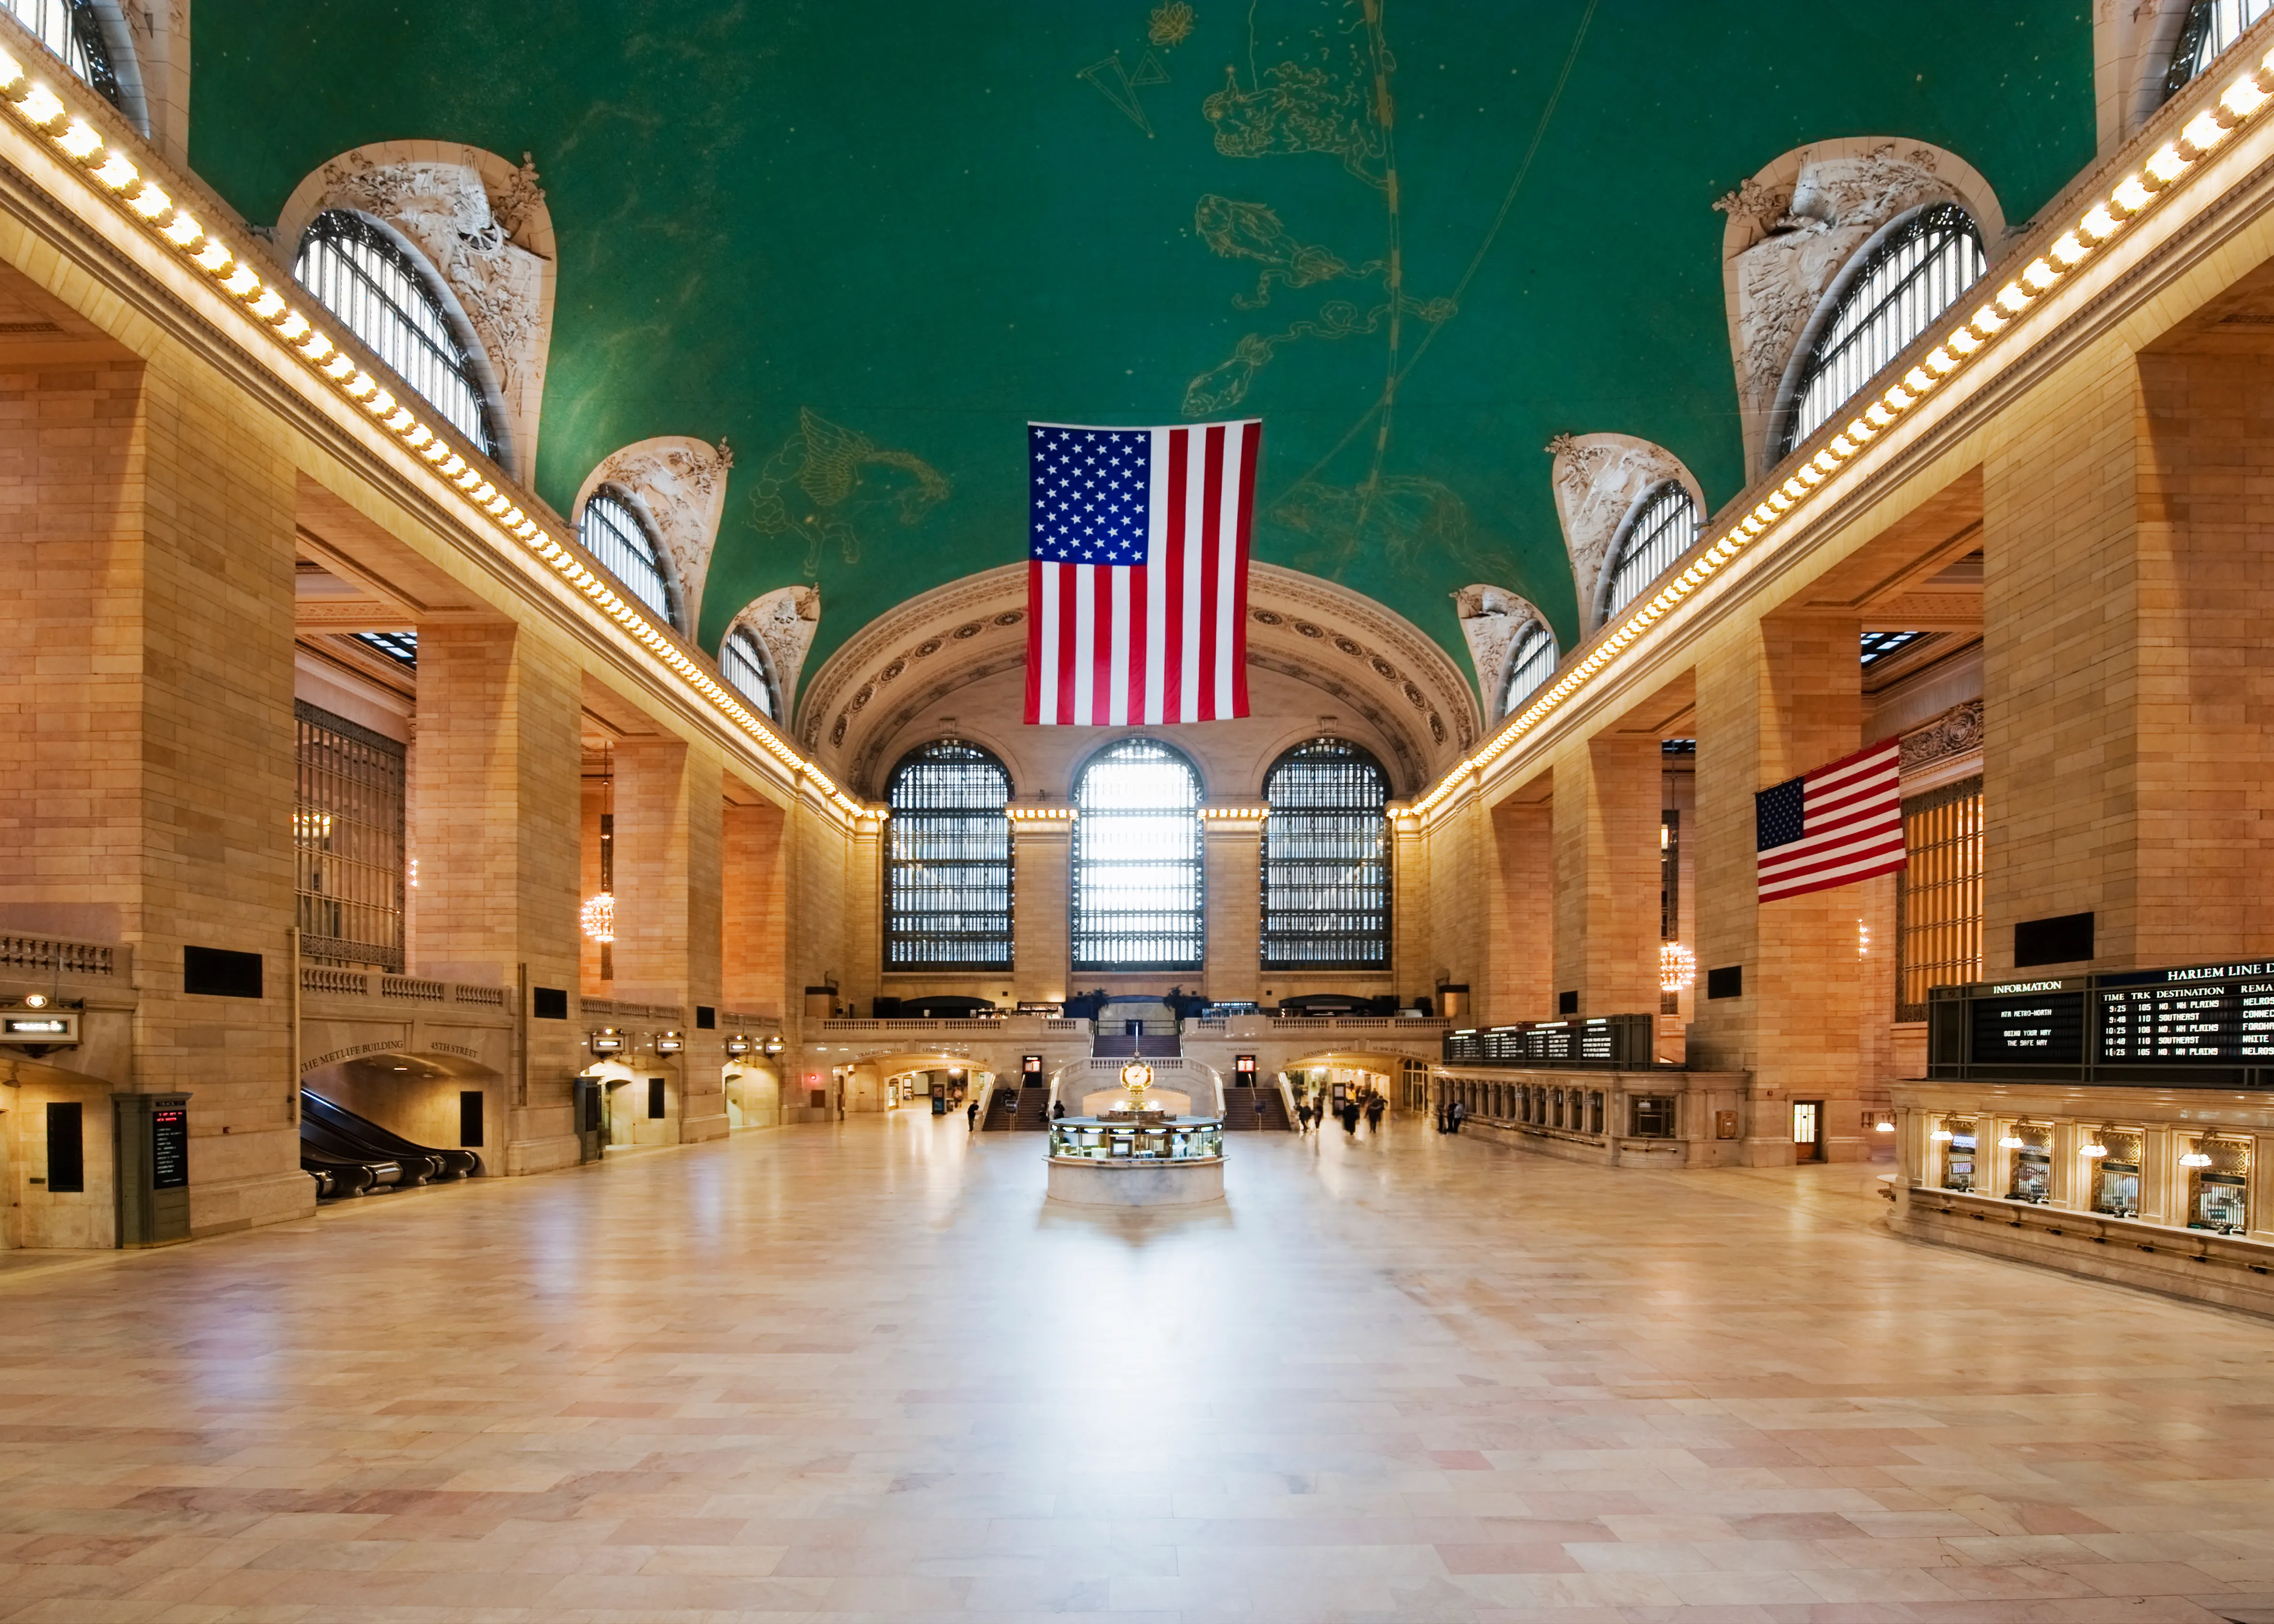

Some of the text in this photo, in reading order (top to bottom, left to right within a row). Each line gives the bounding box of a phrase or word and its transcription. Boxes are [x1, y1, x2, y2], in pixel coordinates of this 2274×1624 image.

[2168, 967, 2224, 981] HARLEM
[2228, 964, 2262, 976] LINE
[1993, 981, 2062, 994] INFORMATION
[2131, 992, 2151, 1000] TRK
[2157, 987, 2224, 998] DESTINATION
[2190, 1000, 2219, 1009] PLAINS
[2014, 1009, 2052, 1017] METRO-NORTH
[2158, 1012, 2200, 1022] SOUTHEAST
[2190, 1024, 2219, 1032] PLAINS
[2158, 1036, 2200, 1044] SOUTHEAST
[2242, 1034, 2269, 1043] WHITE
[319, 1045, 361, 1065] METLIFE
[362, 1040, 403, 1053] BUILDING
[431, 1042, 478, 1058] 45TH STREET
[856, 1050, 880, 1058] TRACKS
[1303, 1047, 1338, 1057] LEXINGTON
